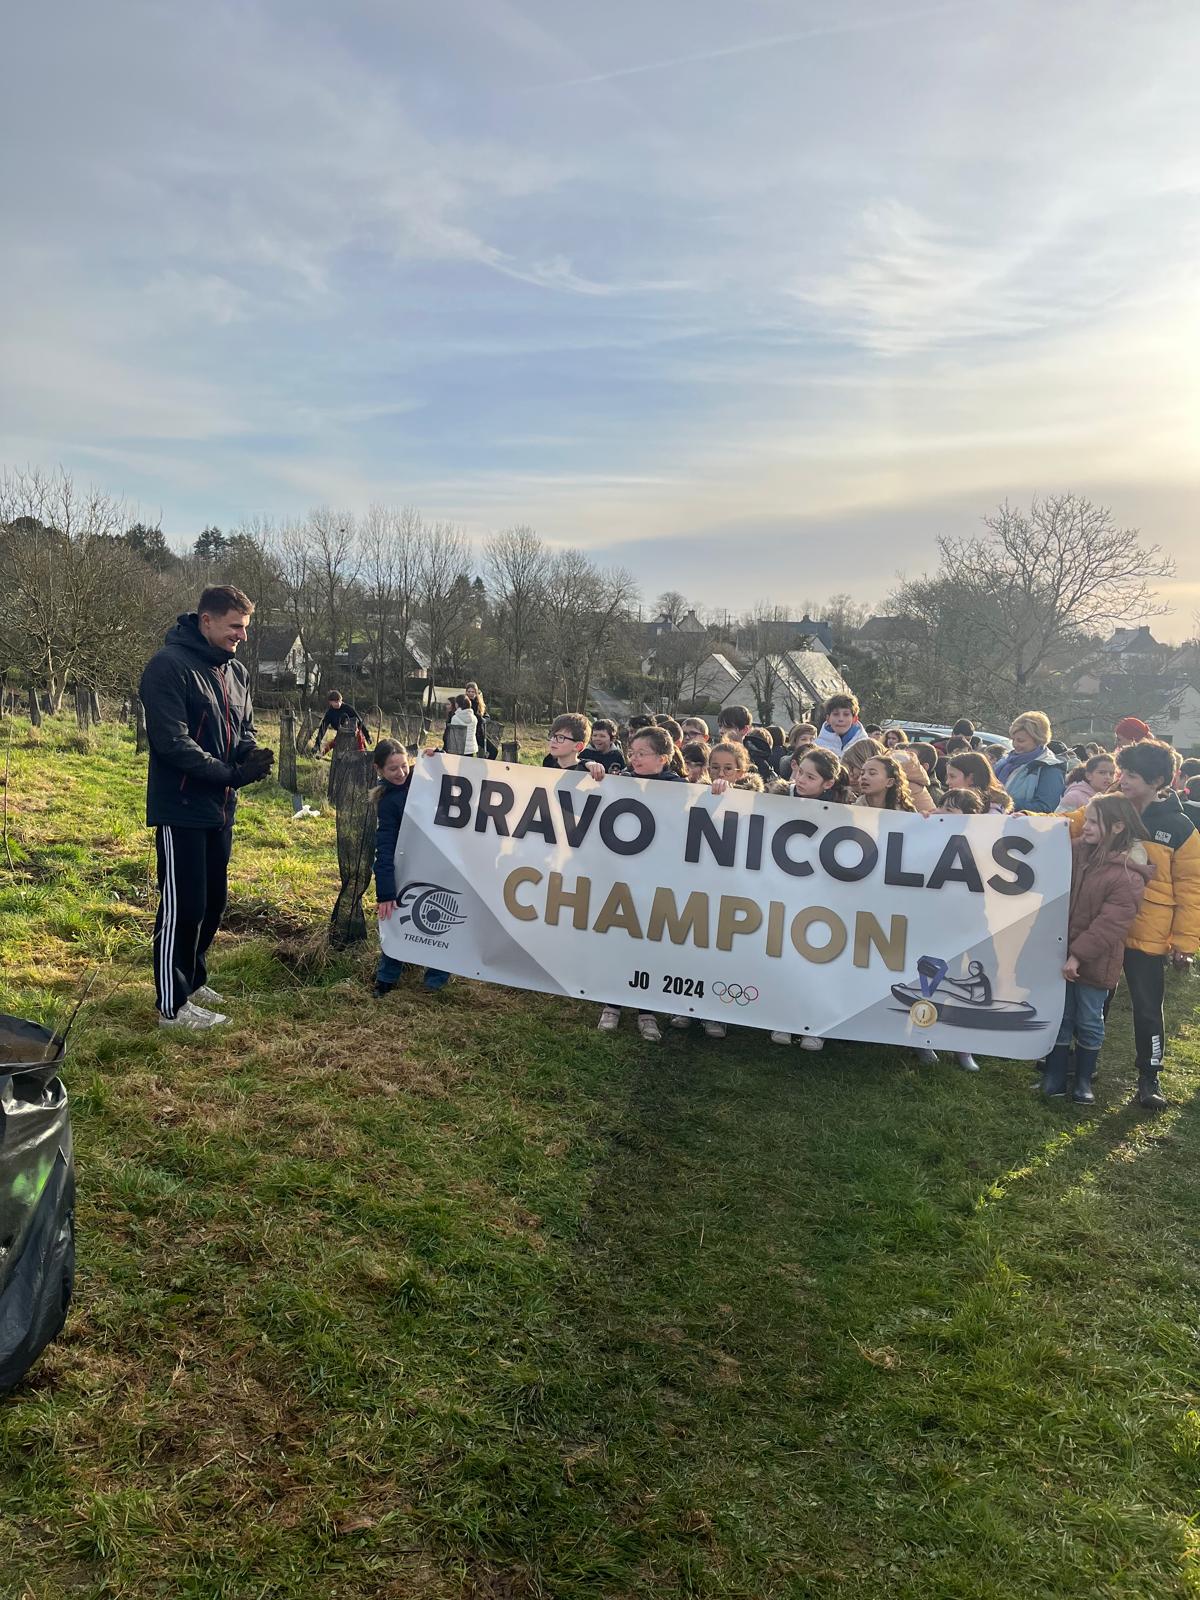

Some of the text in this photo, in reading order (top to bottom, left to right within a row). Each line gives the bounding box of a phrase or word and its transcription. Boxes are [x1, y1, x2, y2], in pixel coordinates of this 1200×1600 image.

[434, 774, 1036, 896] BRAVO NICOLAS
[404, 933, 449, 949] TREMEVEN
[503, 866, 908, 972] CHAMPION
[629, 970, 704, 999] JO 2024
